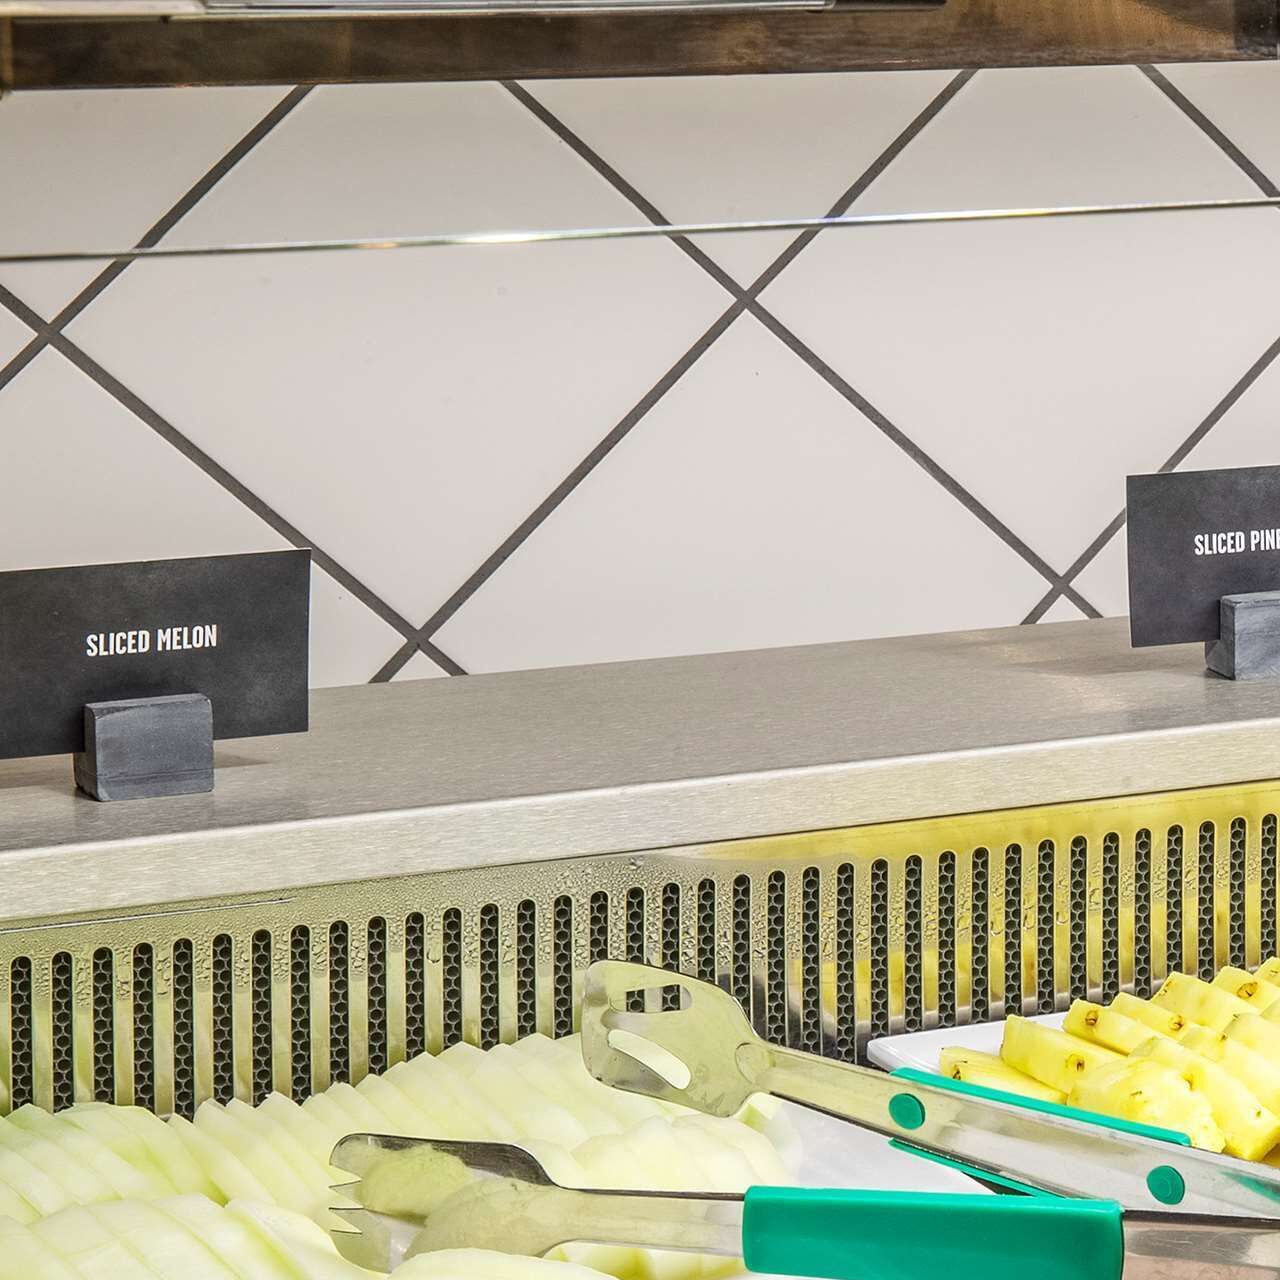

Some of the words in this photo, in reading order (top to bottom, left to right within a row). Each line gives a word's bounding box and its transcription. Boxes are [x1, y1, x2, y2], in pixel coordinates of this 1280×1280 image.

[1194, 531, 1246, 556] SLICED
[86, 629, 150, 657] SLICED
[156, 624, 218, 651] MELON
